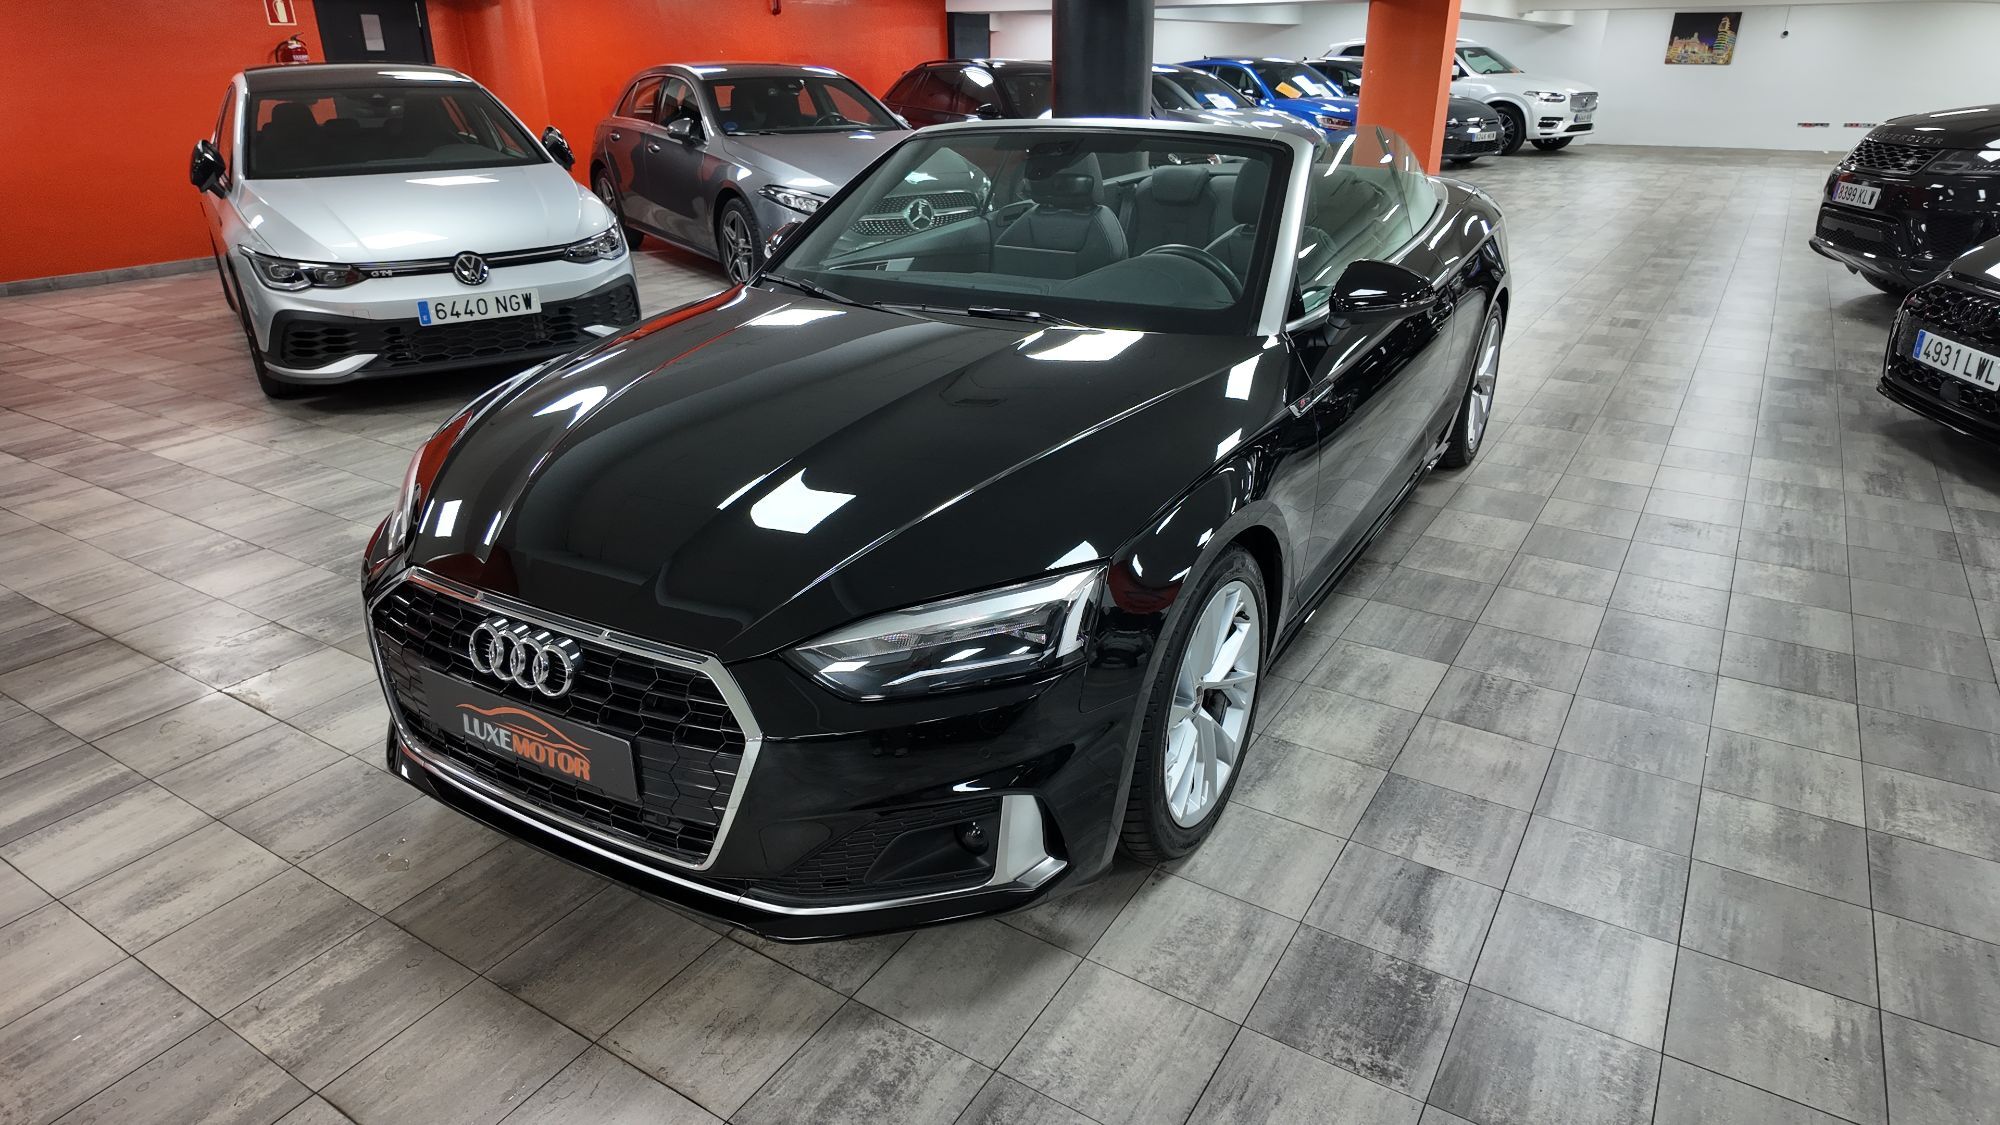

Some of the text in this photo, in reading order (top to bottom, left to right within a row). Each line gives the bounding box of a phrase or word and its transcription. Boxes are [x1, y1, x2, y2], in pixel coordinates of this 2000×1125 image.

[1838, 185, 1858, 202] 8399
[434, 292, 533, 321] 6440 NGW
[1923, 338, 1995, 386] 4931 LWL
[462, 713, 590, 781] LUXEMOTOR
